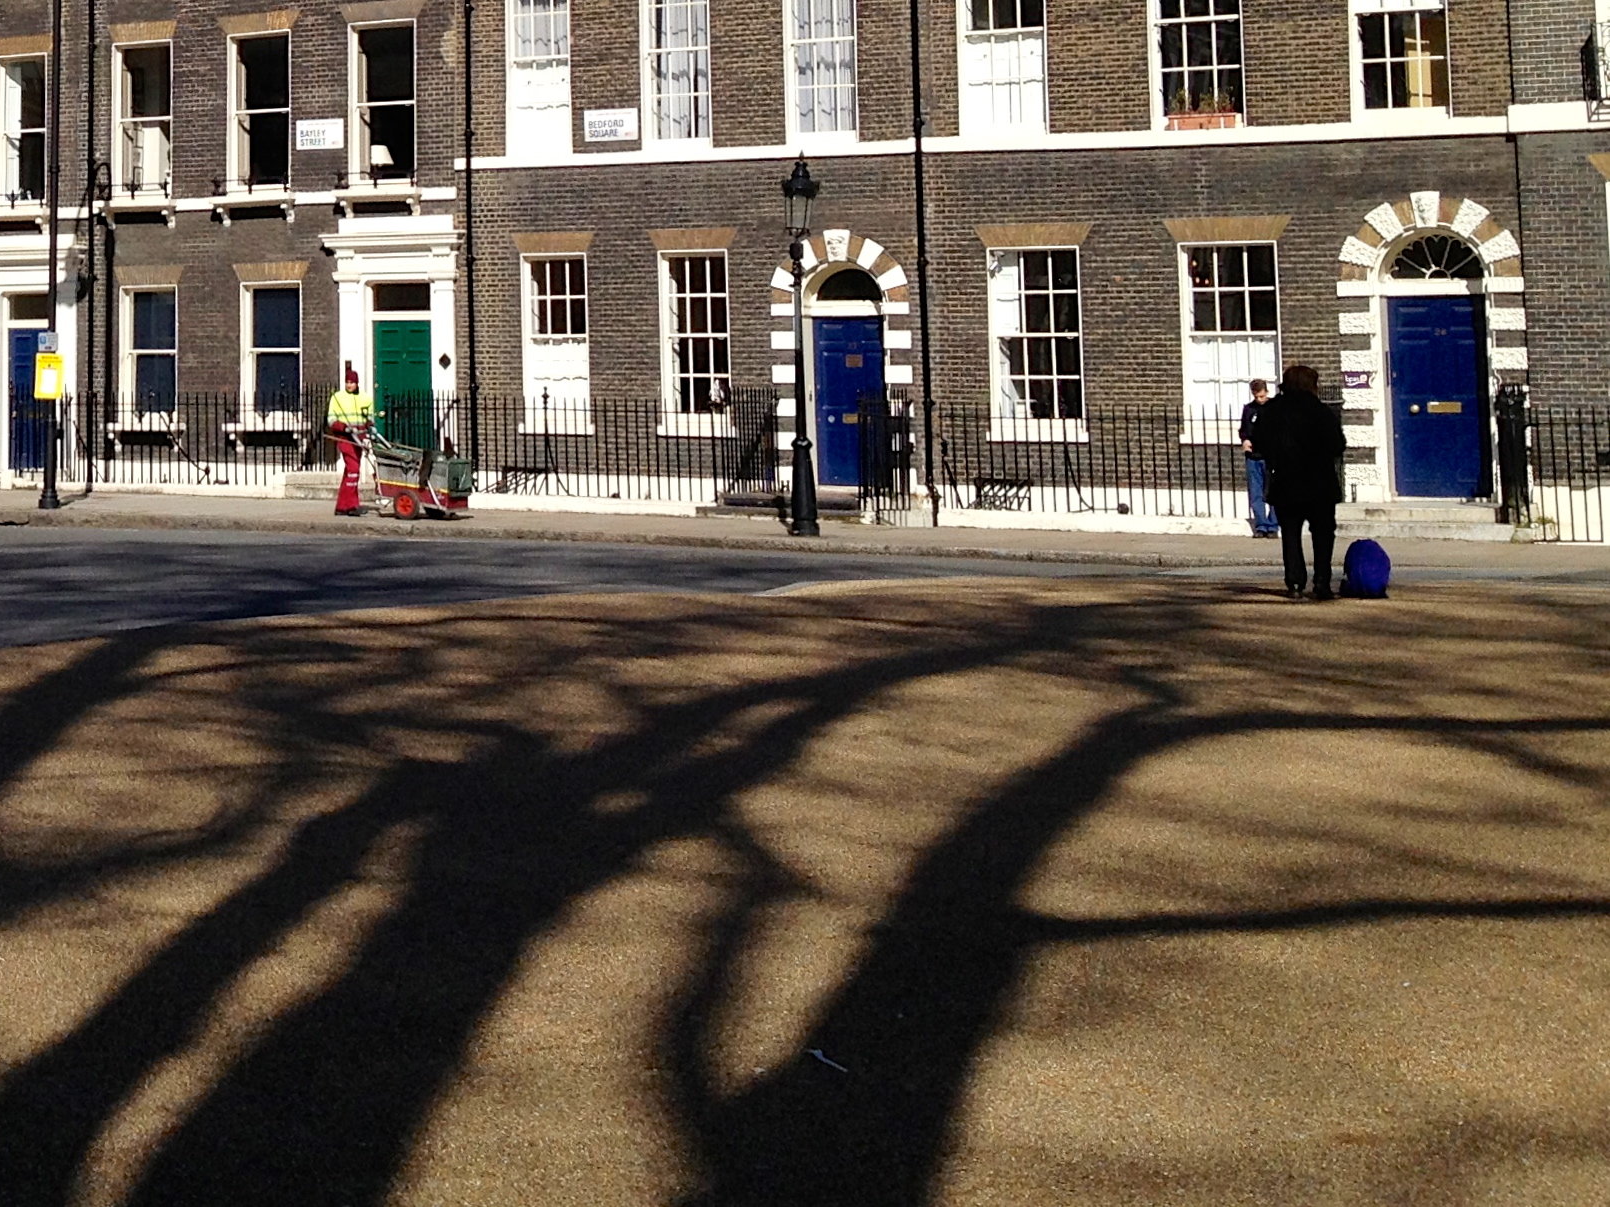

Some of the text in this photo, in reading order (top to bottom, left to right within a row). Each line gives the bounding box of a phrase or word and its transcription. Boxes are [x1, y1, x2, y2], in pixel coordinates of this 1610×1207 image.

[588, 119, 624, 129] BEDFORD
[300, 129, 326, 138] BAYLEY
[588, 128, 619, 138] SQUARE
[300, 137, 326, 147] STREET
